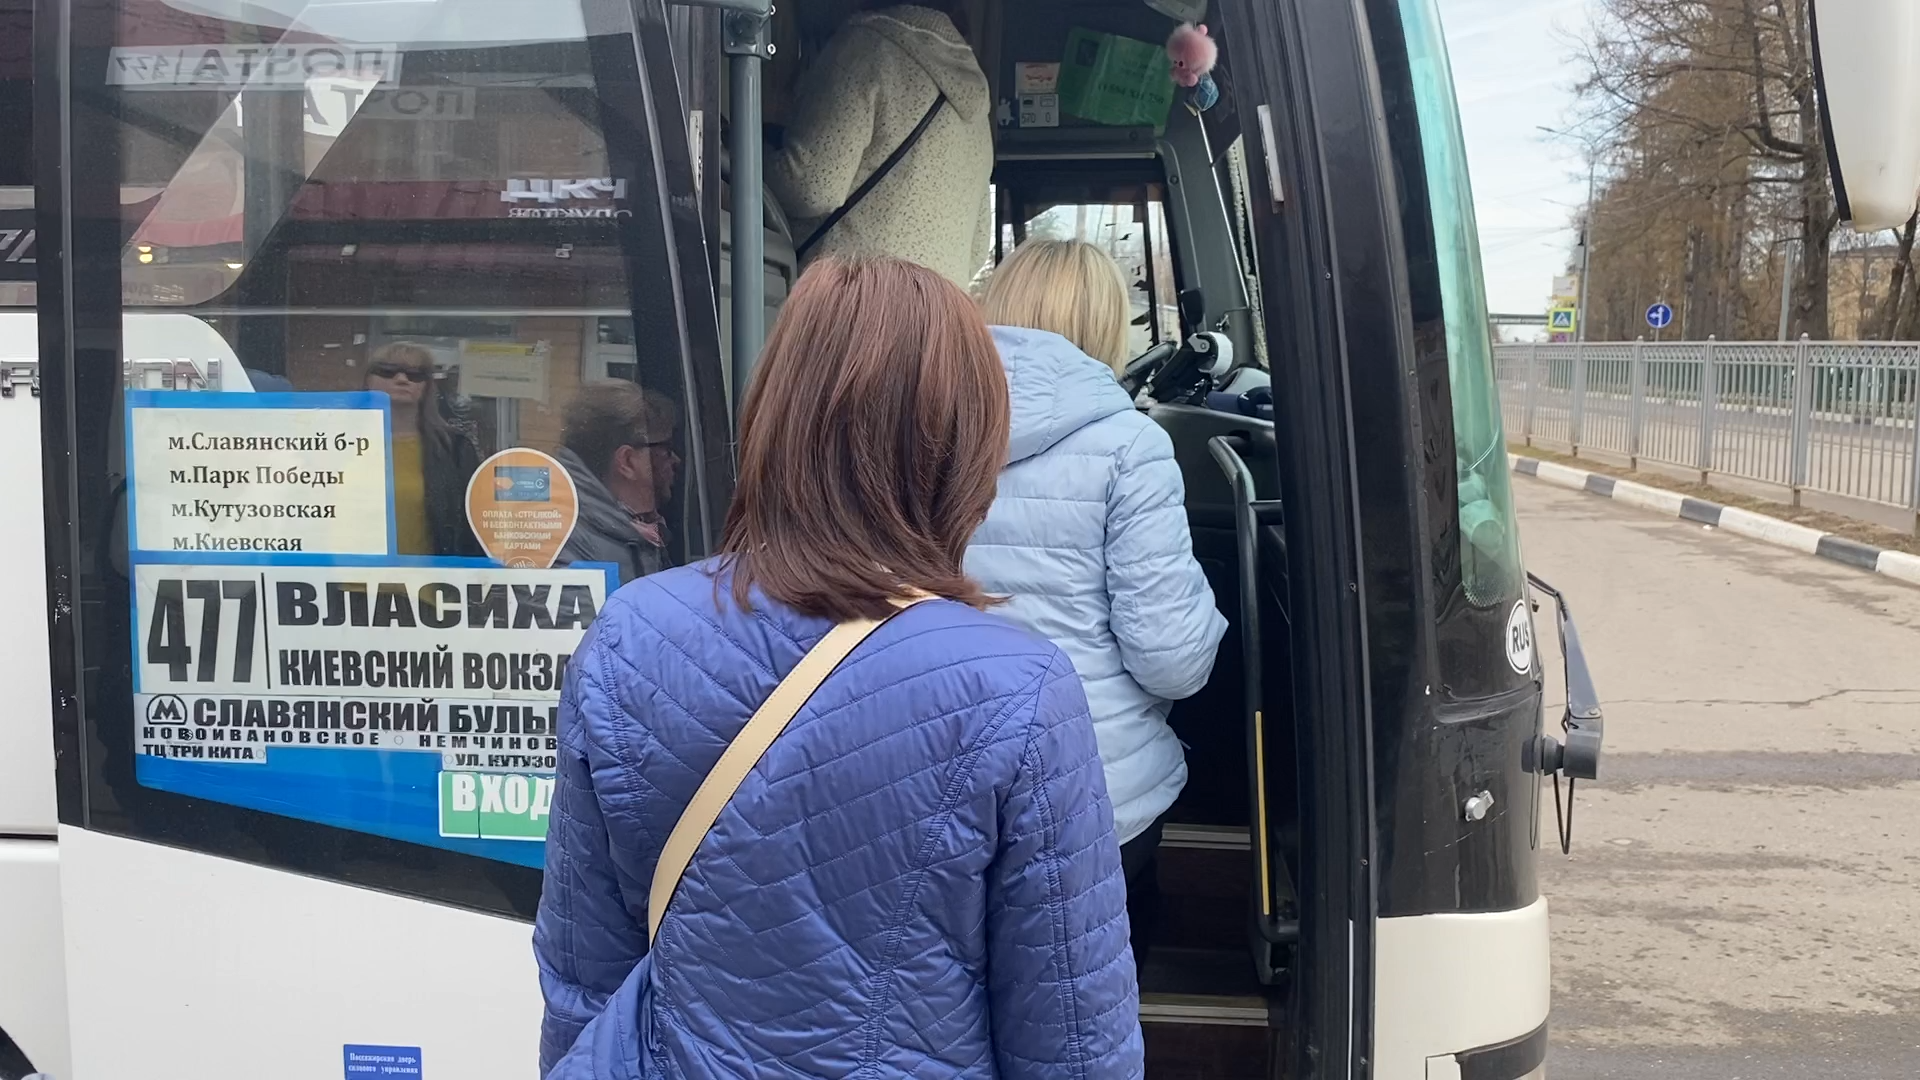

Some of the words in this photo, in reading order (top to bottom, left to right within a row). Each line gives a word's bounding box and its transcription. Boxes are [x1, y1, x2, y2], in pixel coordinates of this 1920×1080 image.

[168, 432, 328, 451] м.Славянский
[334, 432, 370, 456] б-р
[170, 466, 250, 488] м.Парк
[256, 466, 345, 488] Победы
[171, 499, 336, 522] м.Кутузовская
[482, 510, 513, 519] ОПЛАТА
[173, 533, 302, 551] м.Киевская
[504, 542, 541, 550] КАРТАМИ
[276, 581, 598, 630] ВЛАСИХА
[147, 580, 257, 682] 477
[279, 644, 454, 689] КИЕВСКИЙ
[193, 697, 439, 733] СЛАВЯНСКИЙ
[143, 726, 379, 745] НОВОИВАНОВСКОЕ
[143, 744, 166, 758] ТЦ
[170, 745, 203, 759] ТРИ
[208, 746, 254, 760] КИТА
[455, 753, 484, 767] УЛ.
[452, 773, 556, 821] ВХОД
